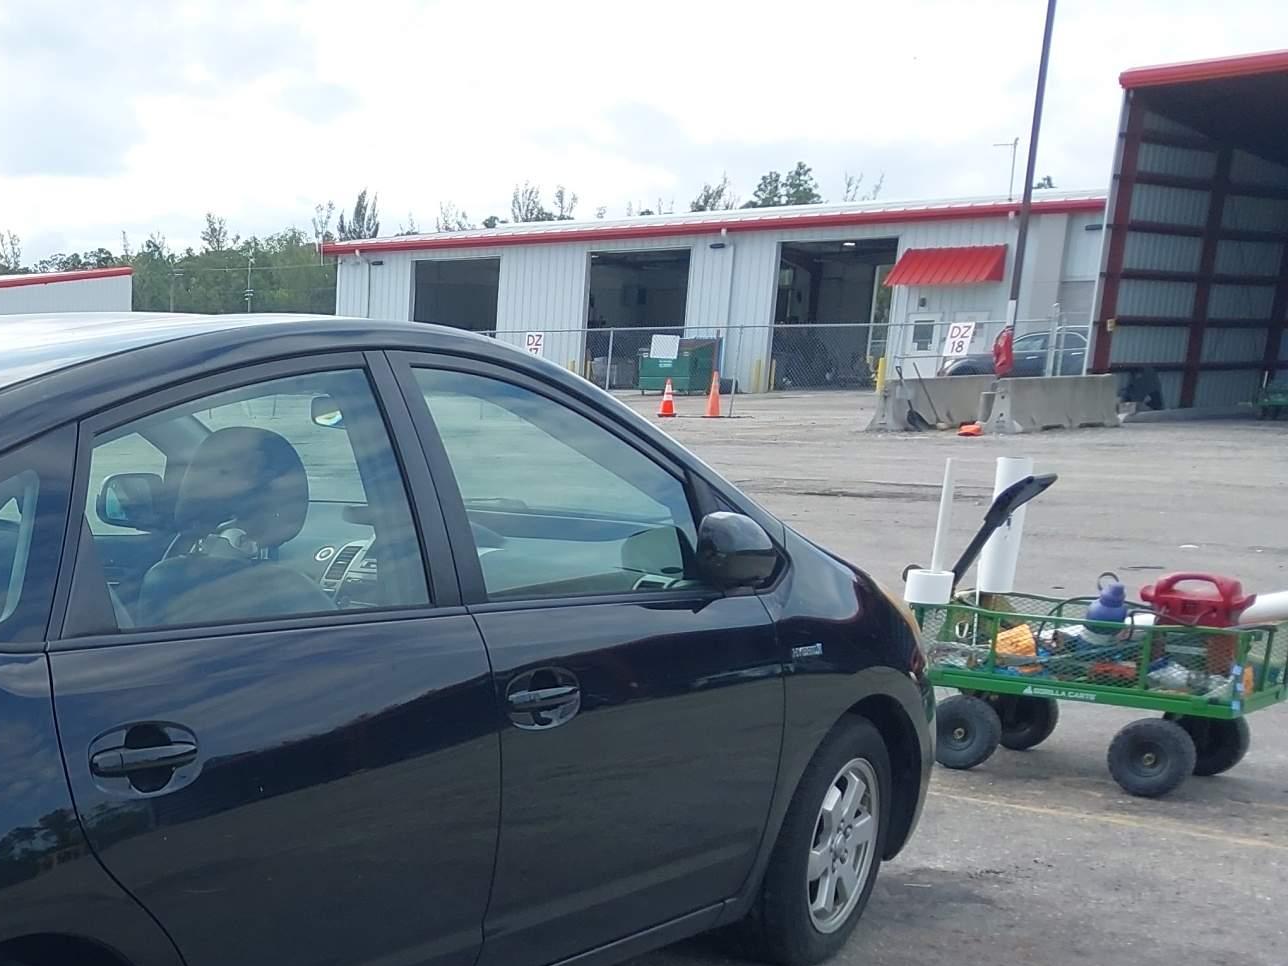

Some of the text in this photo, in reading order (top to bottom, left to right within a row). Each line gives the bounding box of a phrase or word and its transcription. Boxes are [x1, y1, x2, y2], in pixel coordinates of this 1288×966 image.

[950, 325, 972, 339] DZ
[527, 334, 543, 346] DZ
[950, 340, 965, 353] 18
